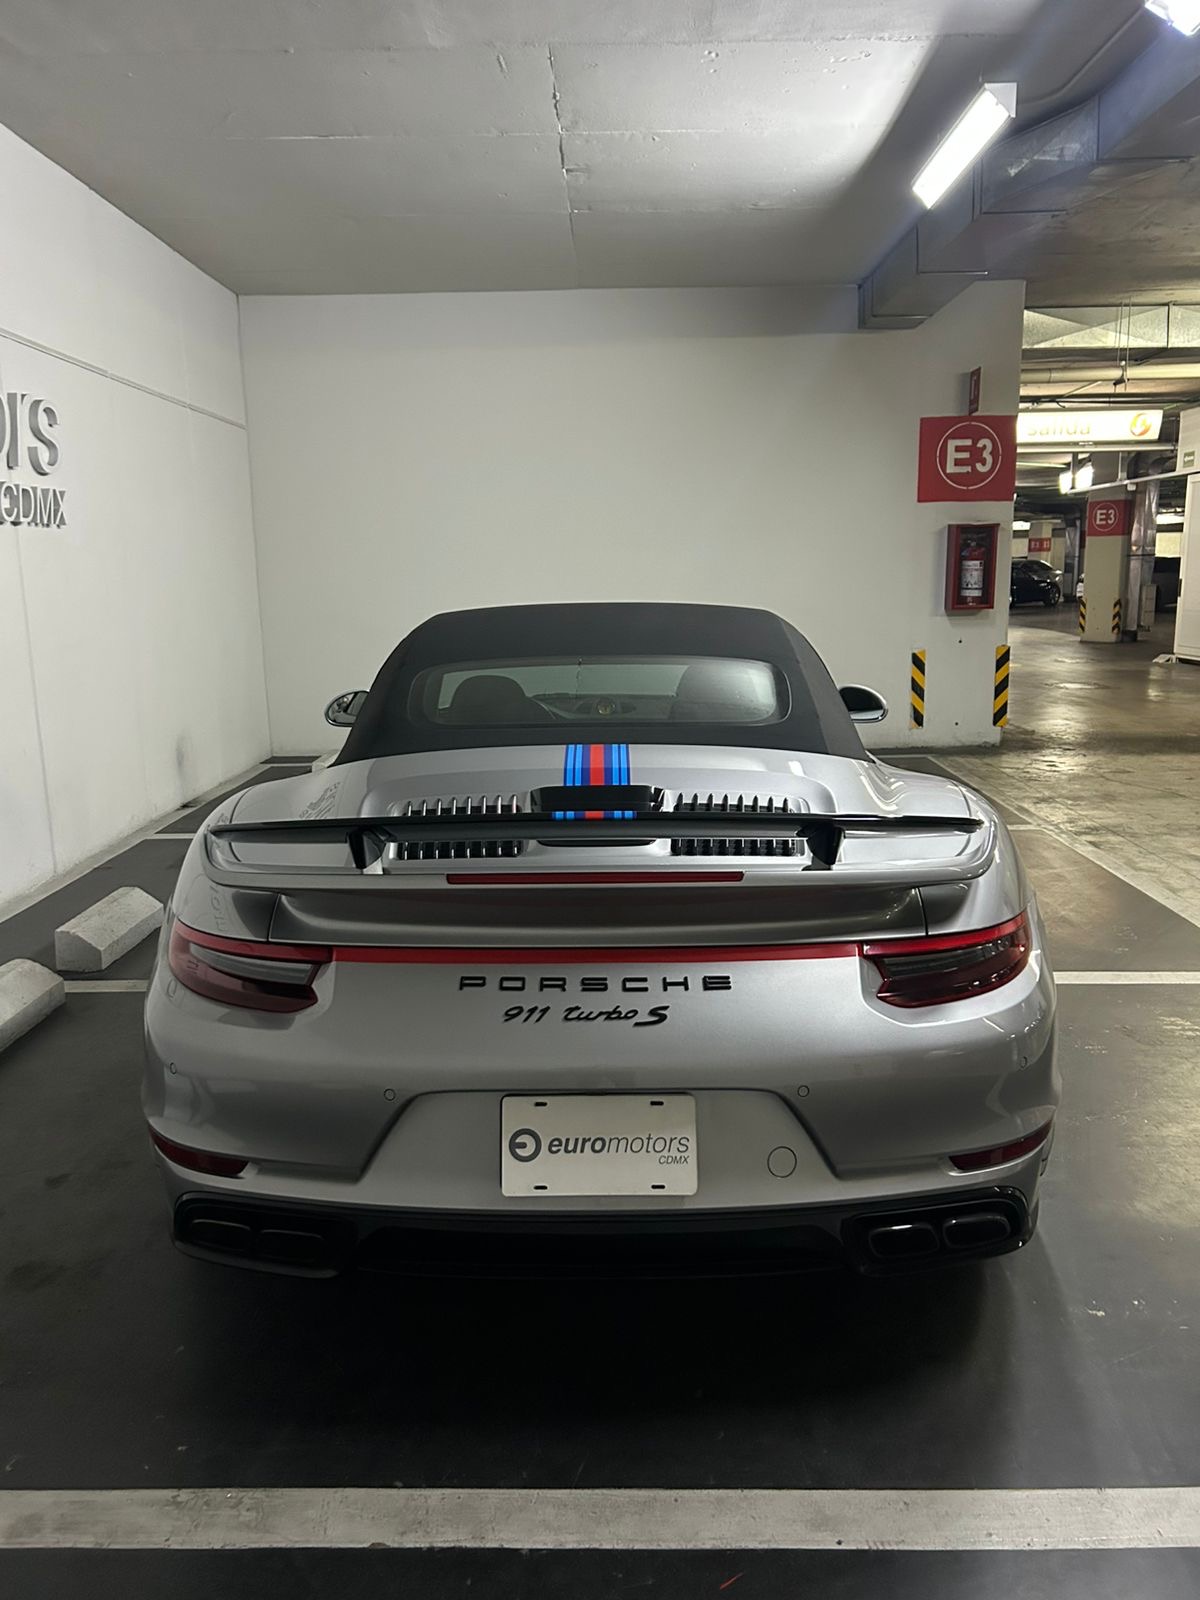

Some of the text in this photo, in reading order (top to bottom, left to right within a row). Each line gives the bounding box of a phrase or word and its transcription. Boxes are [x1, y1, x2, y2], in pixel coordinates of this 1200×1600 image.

[946, 438, 994, 474] E3
[0, 482, 68, 528] CDMX
[1096, 509, 1116, 525] E3
[459, 975, 732, 992] PORSCHE
[503, 1005, 670, 1027] 911 turbo S
[547, 1133, 690, 1154] euromotors
[658, 1155, 690, 1165] CDMX
